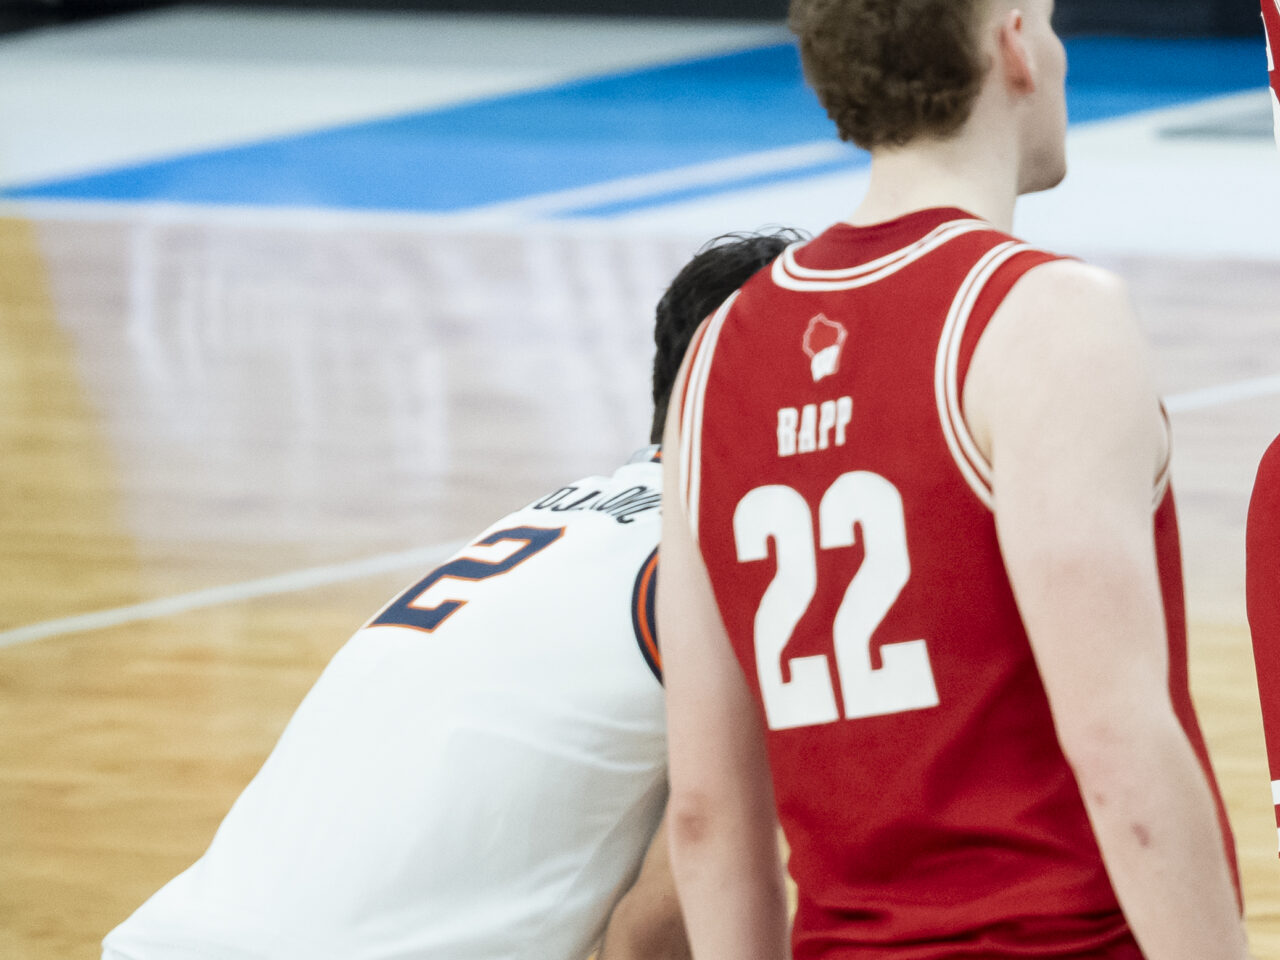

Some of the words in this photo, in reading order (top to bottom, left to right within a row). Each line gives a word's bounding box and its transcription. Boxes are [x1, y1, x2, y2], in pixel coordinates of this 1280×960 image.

[777, 396, 854, 457] RAPP
[368, 525, 566, 634] 2
[733, 470, 940, 731] 22
